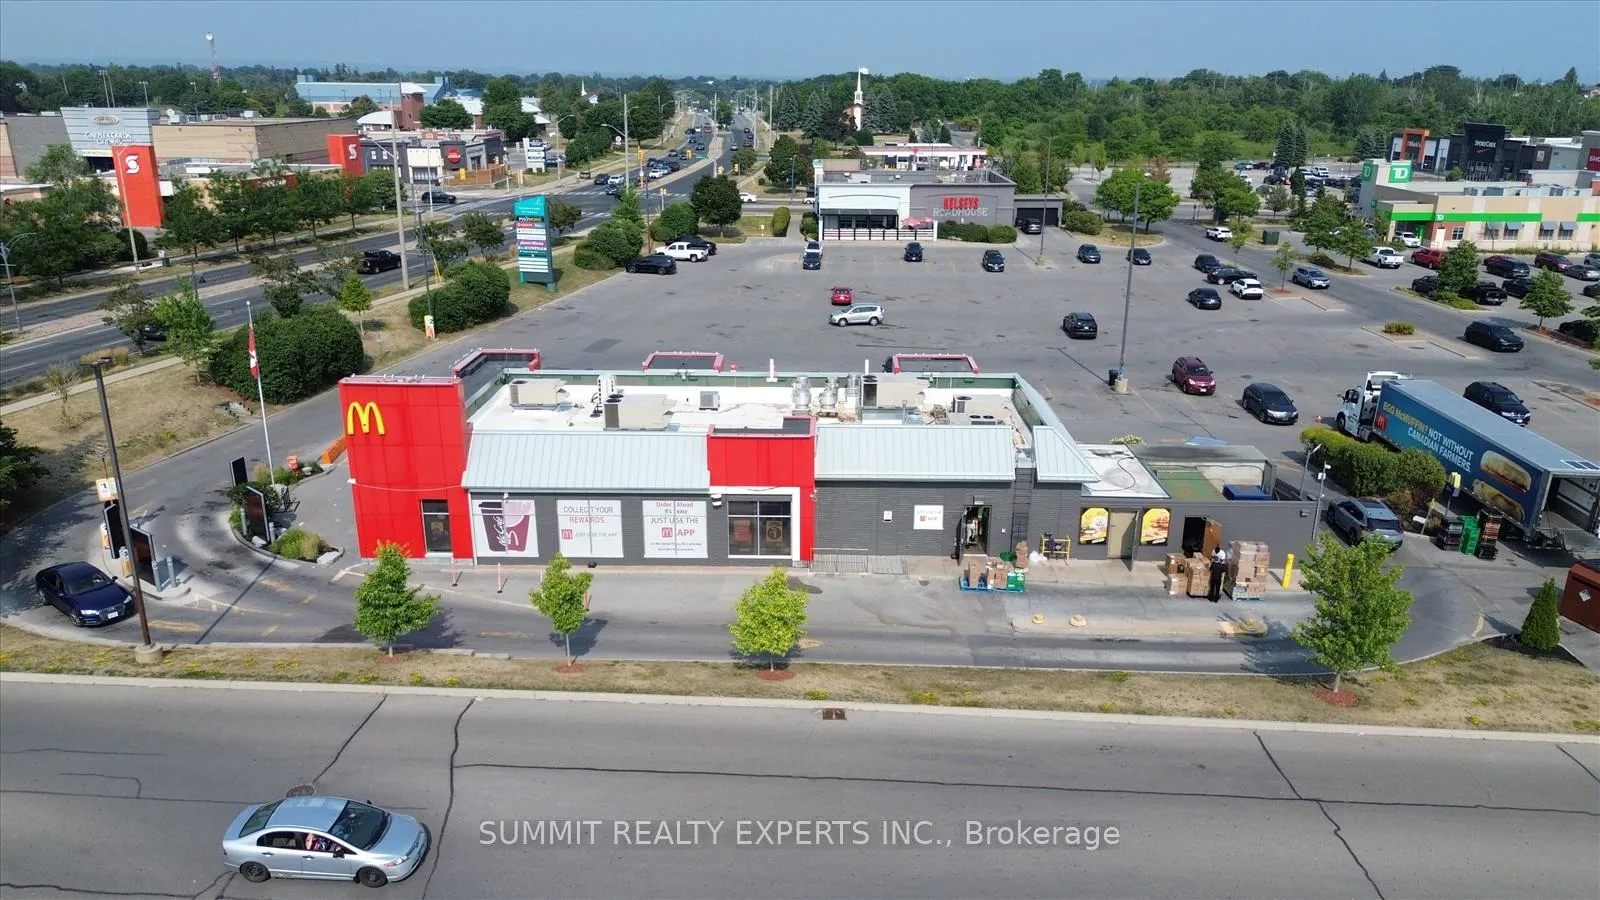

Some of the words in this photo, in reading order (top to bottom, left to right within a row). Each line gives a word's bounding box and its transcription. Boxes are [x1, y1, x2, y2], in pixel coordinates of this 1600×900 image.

[1392, 167, 1409, 179] TD
[943, 197, 979, 209] KELSEYS
[932, 207, 989, 217] ROADHOUSE
[1407, 427, 1440, 454] CANADIAN
[1438, 446, 1472, 473] FARMERS.
[1428, 427, 1443, 442] NOT
[1442, 436, 1474, 461] WITHOUT
[563, 506, 594, 514] COLLECT
[595, 506, 614, 514] YOUR
[677, 529, 696, 537] APP
